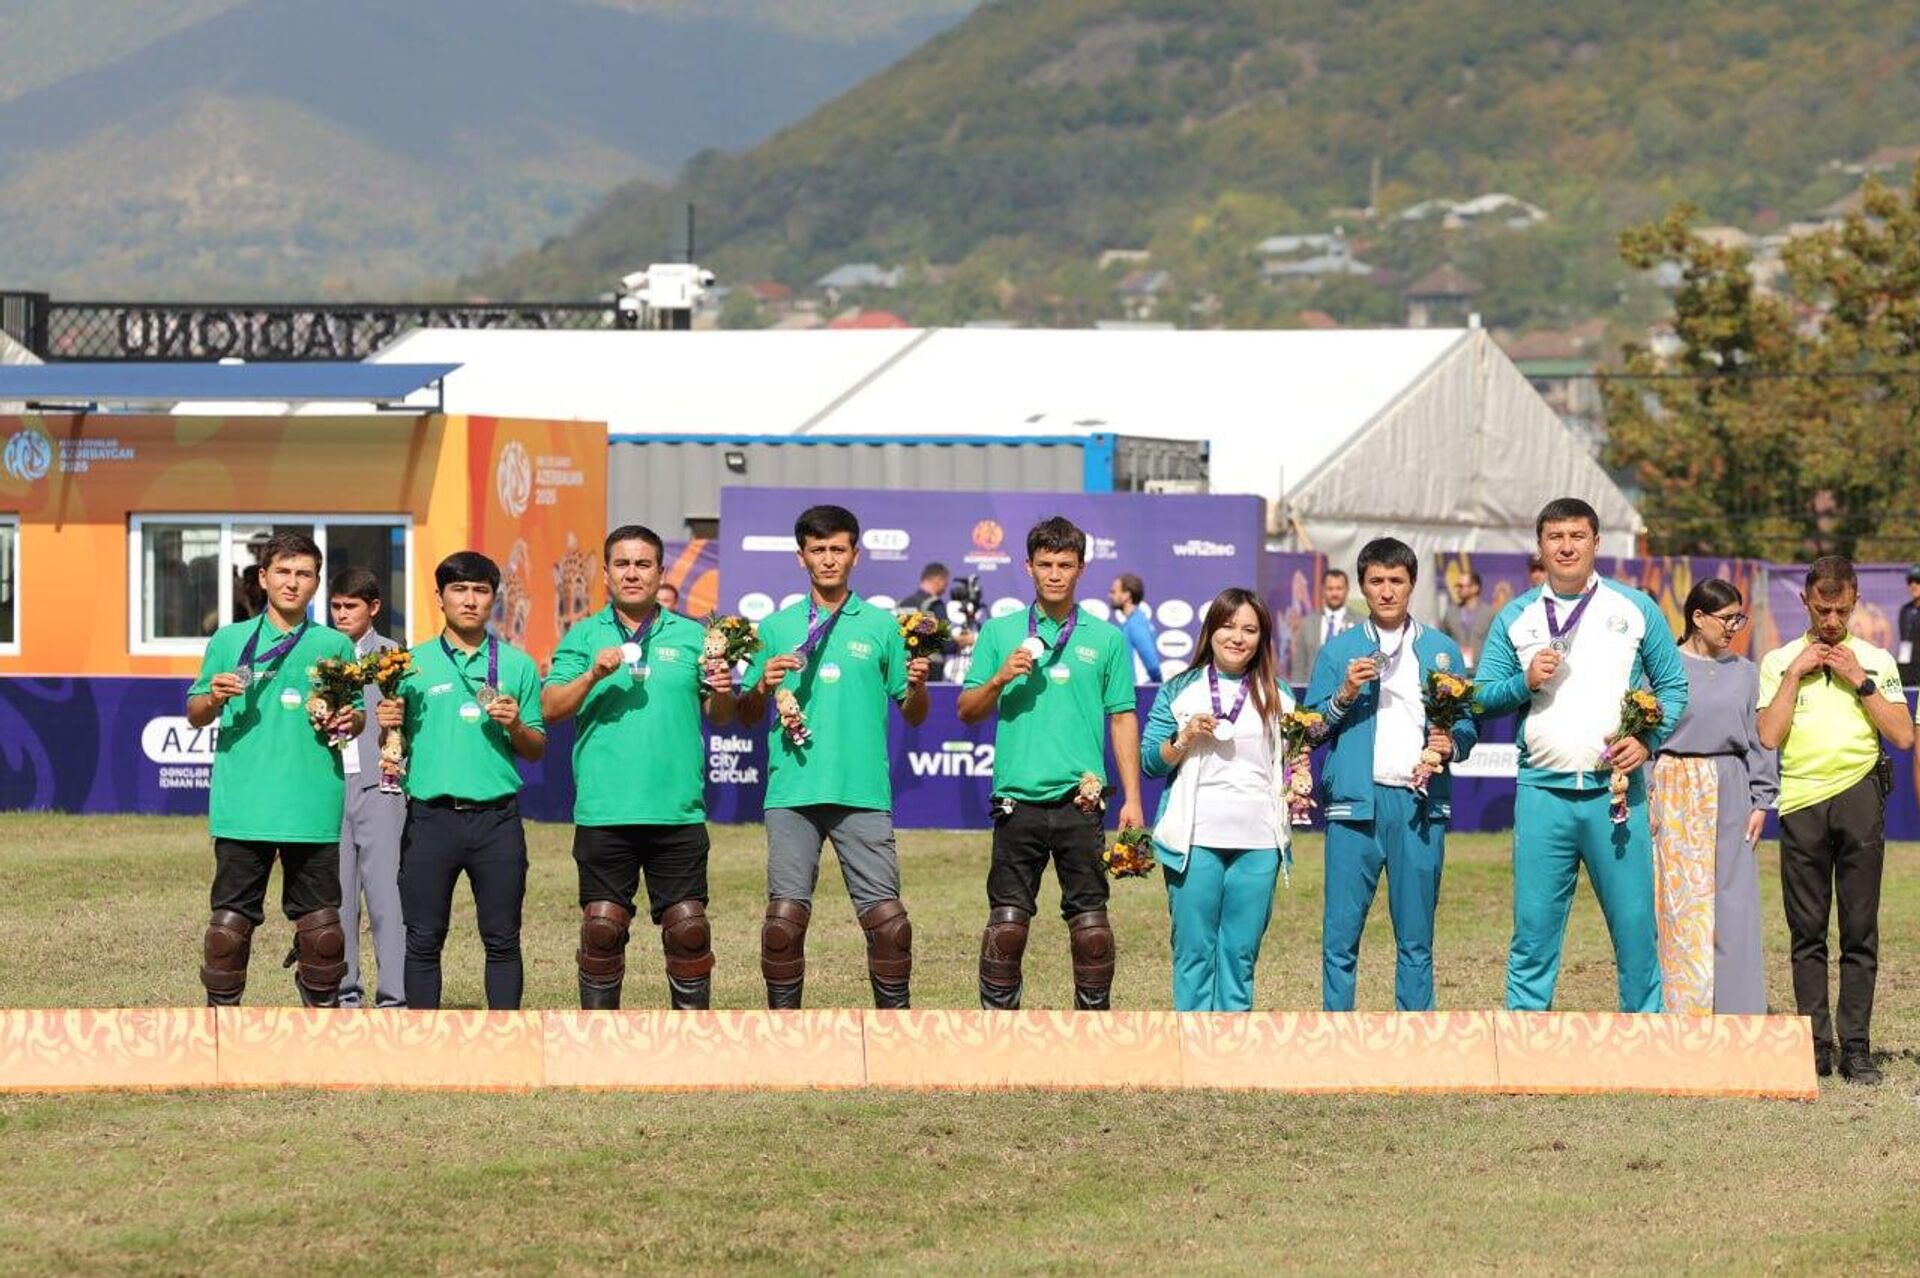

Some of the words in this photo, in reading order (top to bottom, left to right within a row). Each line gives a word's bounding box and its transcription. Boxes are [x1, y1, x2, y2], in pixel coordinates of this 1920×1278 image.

[710, 735, 753, 752] Baku
[709, 753, 739, 771] city
[709, 766, 759, 783] circuit
